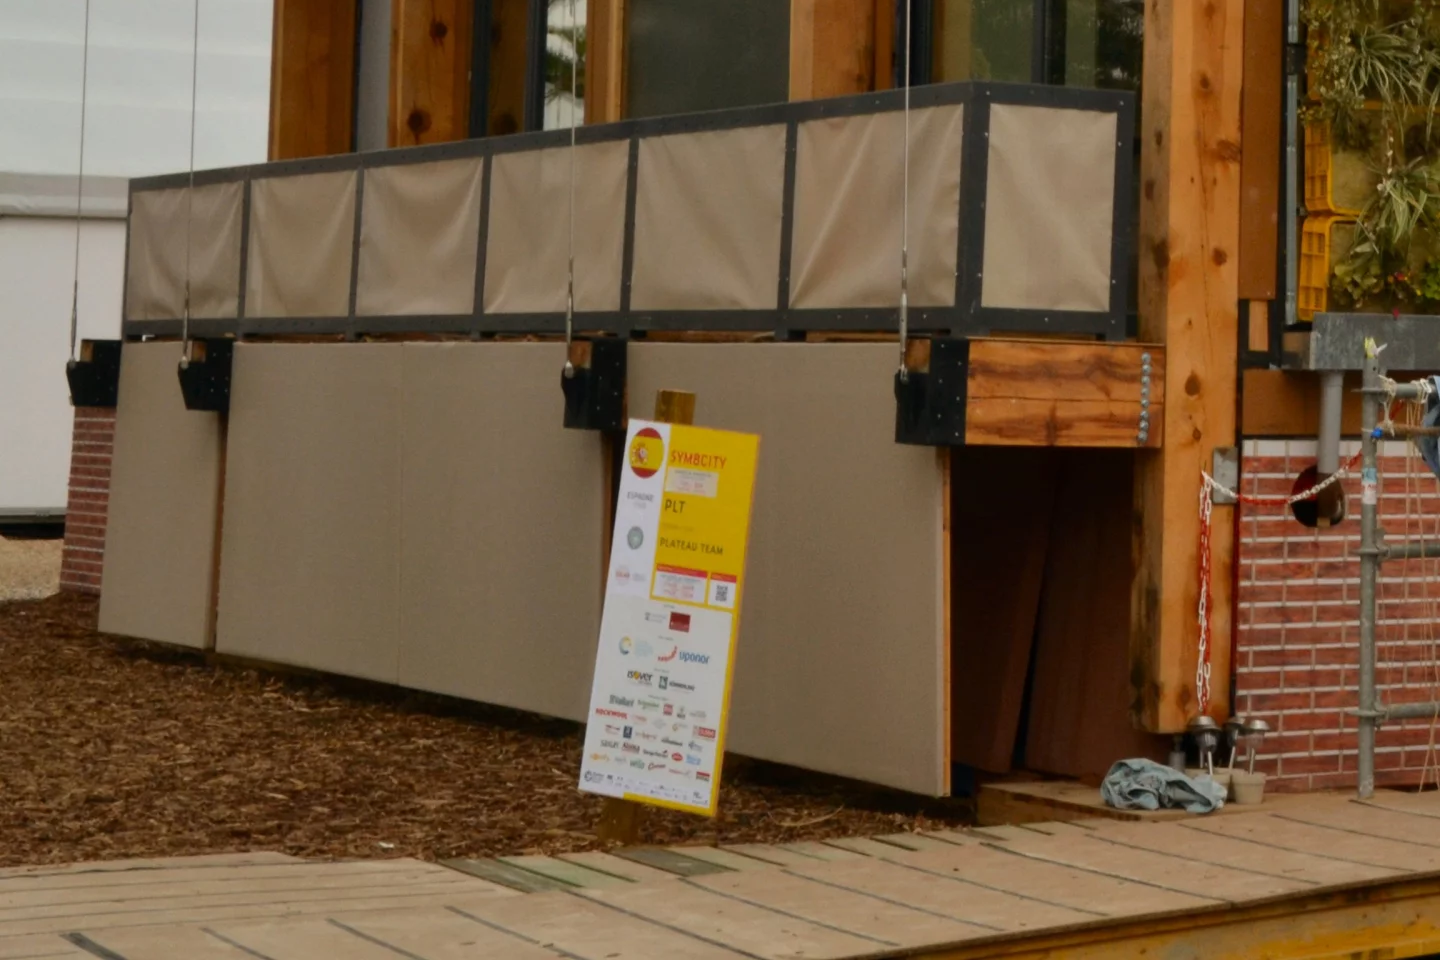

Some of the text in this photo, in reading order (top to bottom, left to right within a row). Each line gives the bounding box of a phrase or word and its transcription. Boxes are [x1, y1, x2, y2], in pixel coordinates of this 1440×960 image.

[665, 499, 686, 514] PLT
[660, 537, 724, 556] PLATEAU TEAM
[679, 650, 710, 664] uponor
